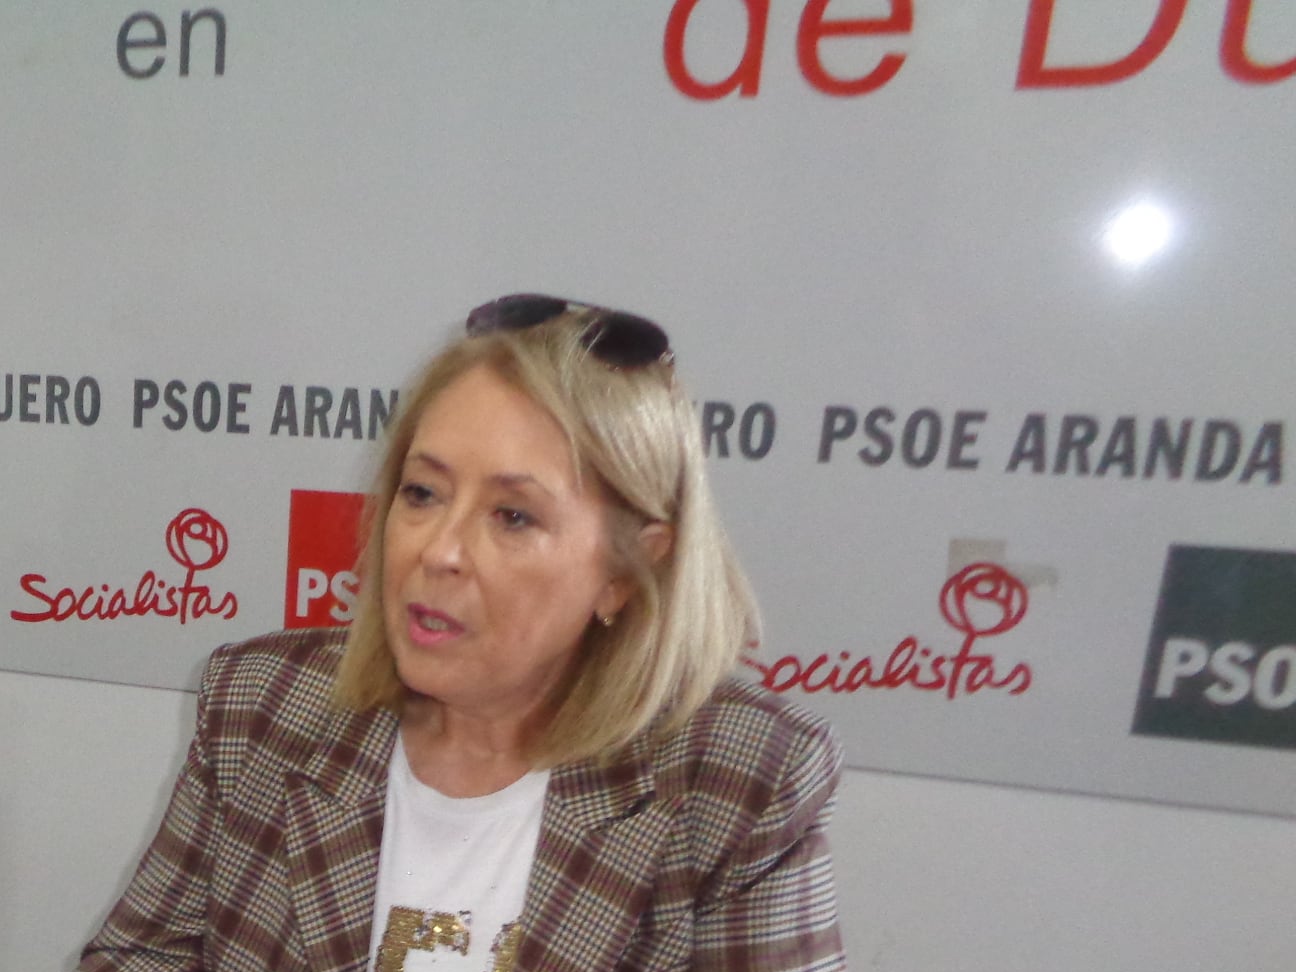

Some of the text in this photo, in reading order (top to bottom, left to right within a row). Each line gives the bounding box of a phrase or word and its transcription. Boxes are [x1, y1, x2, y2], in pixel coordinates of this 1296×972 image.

[116, 8, 226, 80] en
[132, 379, 252, 435] PSOE
[817, 405, 987, 470] PSOE
[1006, 413, 1284, 486] ARANDA
[11, 570, 238, 625] Socialistas
